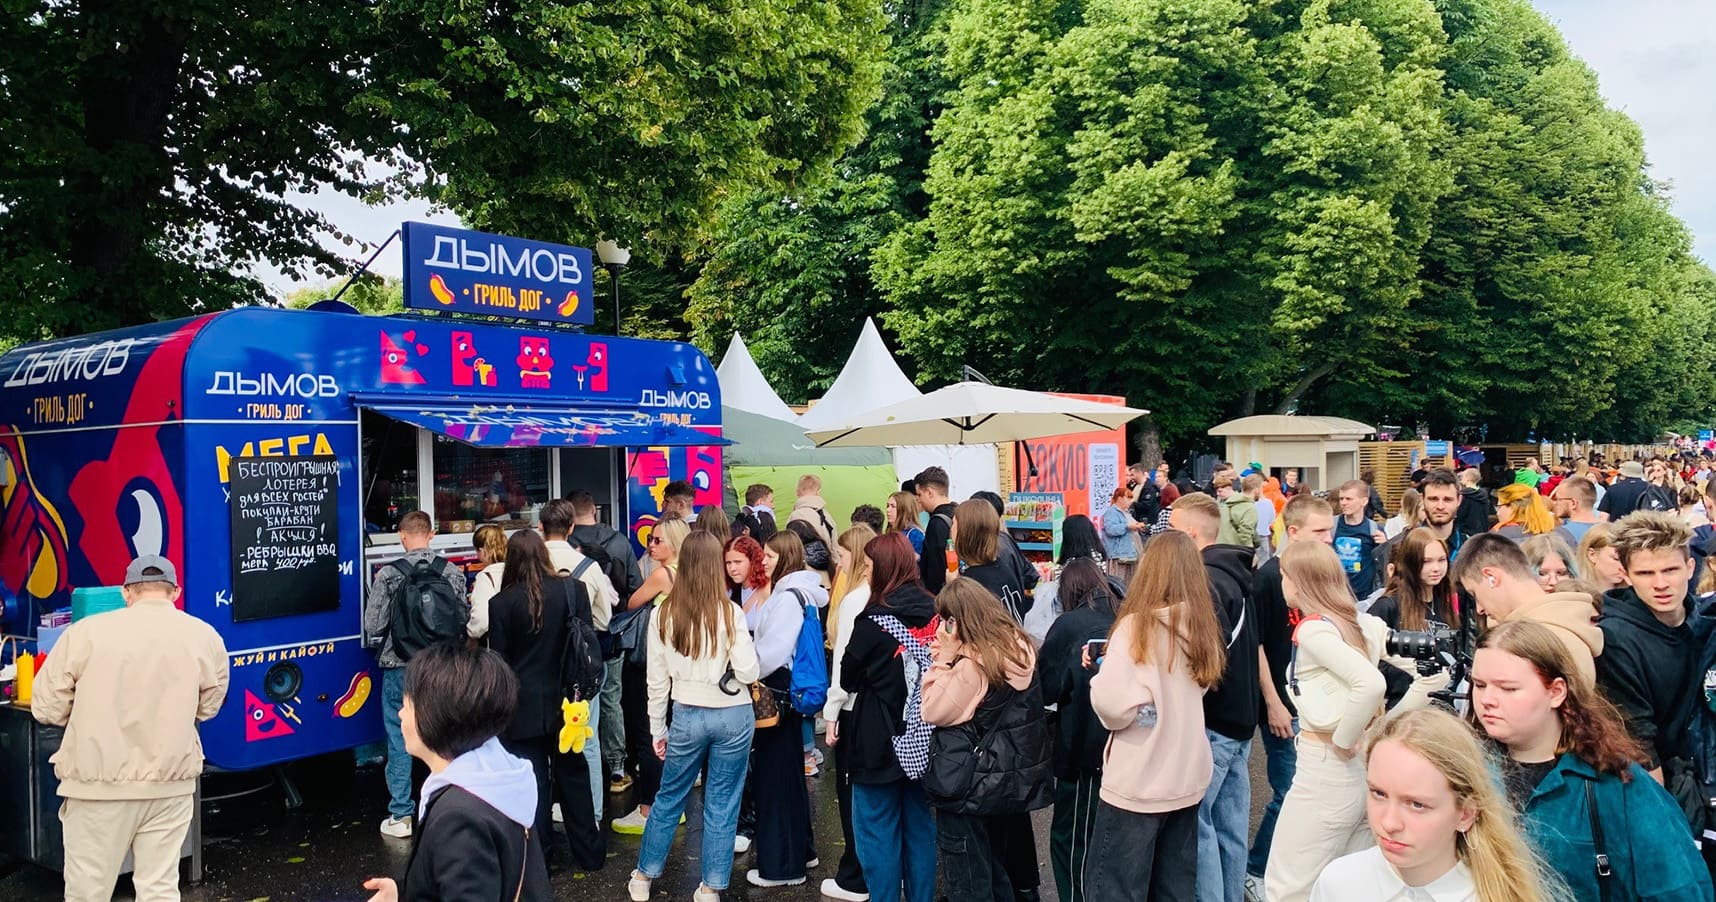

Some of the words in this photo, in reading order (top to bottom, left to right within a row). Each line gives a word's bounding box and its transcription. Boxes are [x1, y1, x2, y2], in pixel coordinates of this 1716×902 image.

[424, 235, 582, 285] ДЫМОВ
[473, 283, 517, 308] ГРИЛЬ
[518, 288, 543, 312] ДОГ
[4, 338, 135, 388] ДЫМОВ
[206, 371, 339, 398] ДЫМОВ
[34, 396, 65, 424] ГРИЛЬ
[67, 393, 87, 424] ДОГ
[639, 389, 711, 409] ДЫМОВ
[247, 404, 282, 418] ГРИЛЬ
[284, 404, 304, 421] ДОГ
[238, 461, 337, 479] БЕСПРОИГРЫШНАЯ
[263, 478, 317, 490] ЛОТЕРЕЯ
[262, 491, 289, 503] ВСЕХ
[265, 516, 313, 528] БАРАБАН
[233, 650, 264, 667] ЖУЙ
[268, 652, 276, 662] И
